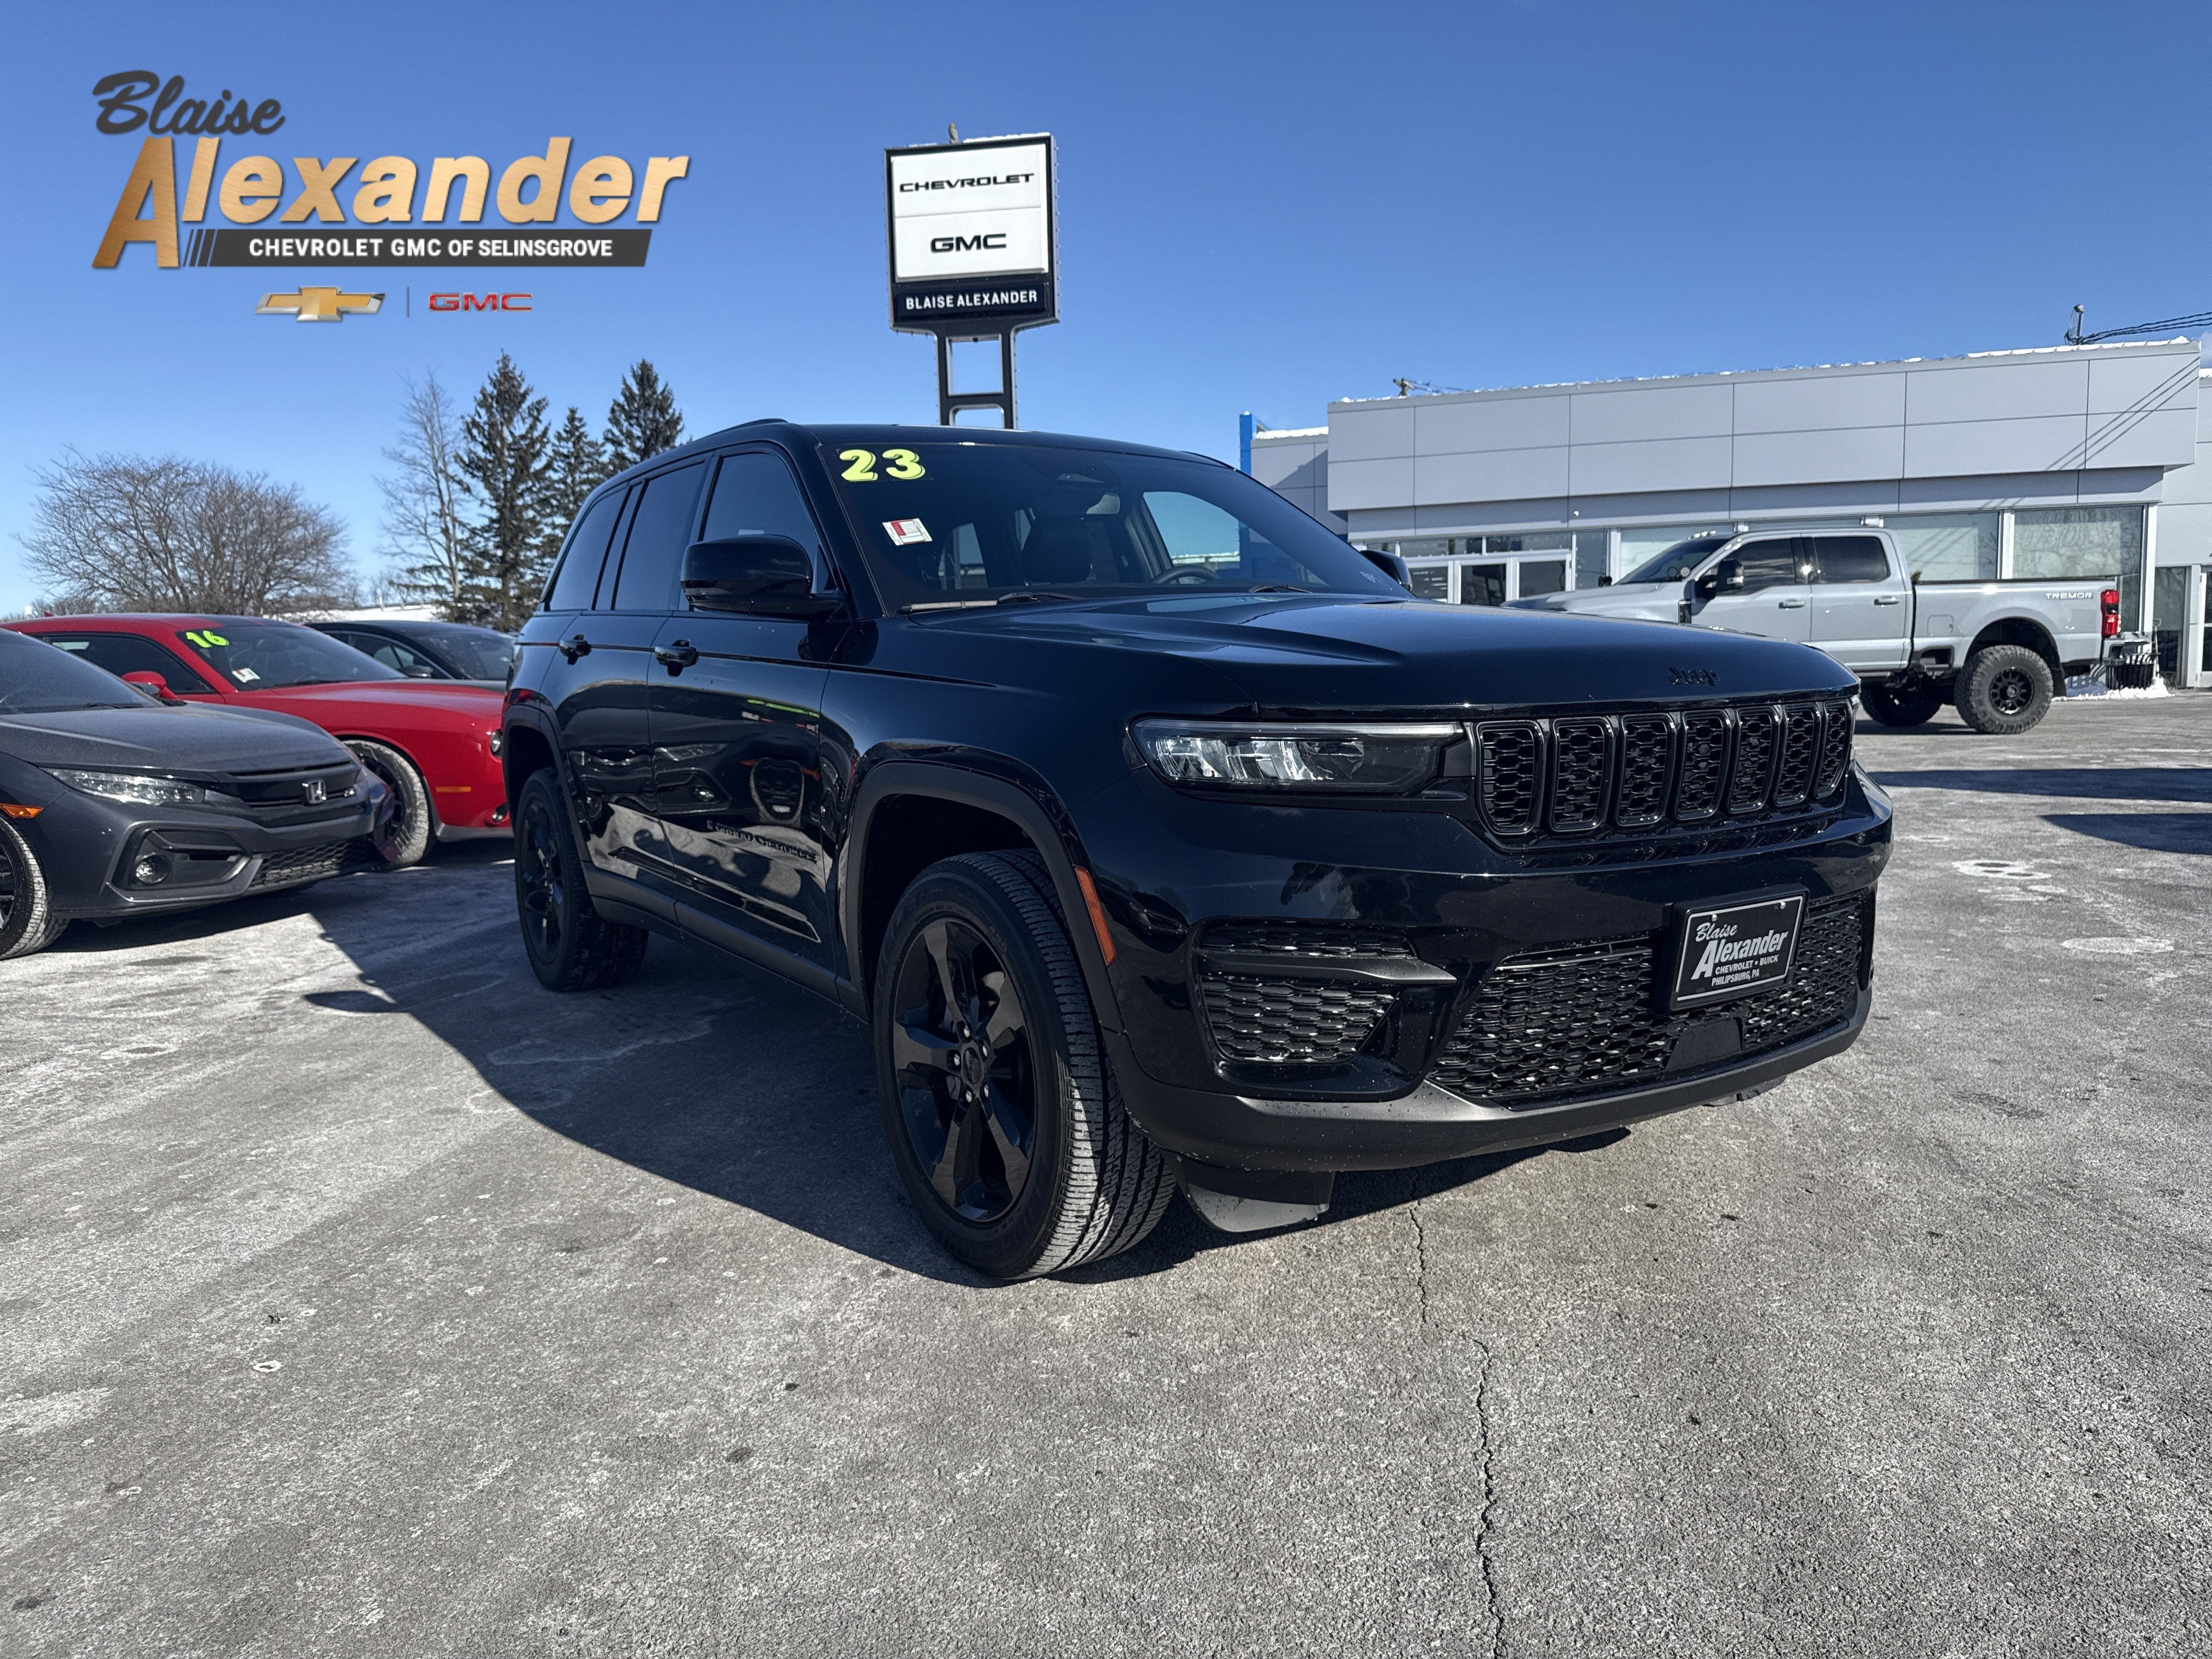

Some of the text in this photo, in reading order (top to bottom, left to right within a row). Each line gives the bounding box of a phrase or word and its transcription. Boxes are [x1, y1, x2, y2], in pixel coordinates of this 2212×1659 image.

[899, 173, 1035, 193] CHEVROLET
[930, 233, 1007, 253] GMC
[906, 290, 1037, 310] BLAISE ALEXANDER
[839, 449, 926, 482] 23
[2045, 591, 2094, 600] TREMOR
[186, 630, 229, 648] 16
[1668, 666, 1720, 686] Jeep
[1695, 922, 1737, 942] Blaise
[1690, 929, 1788, 980] Alexander
[1715, 955, 1778, 975] CHEVROLET BUICK
[1711, 969, 1759, 986] PHILIPSBURG, PA
